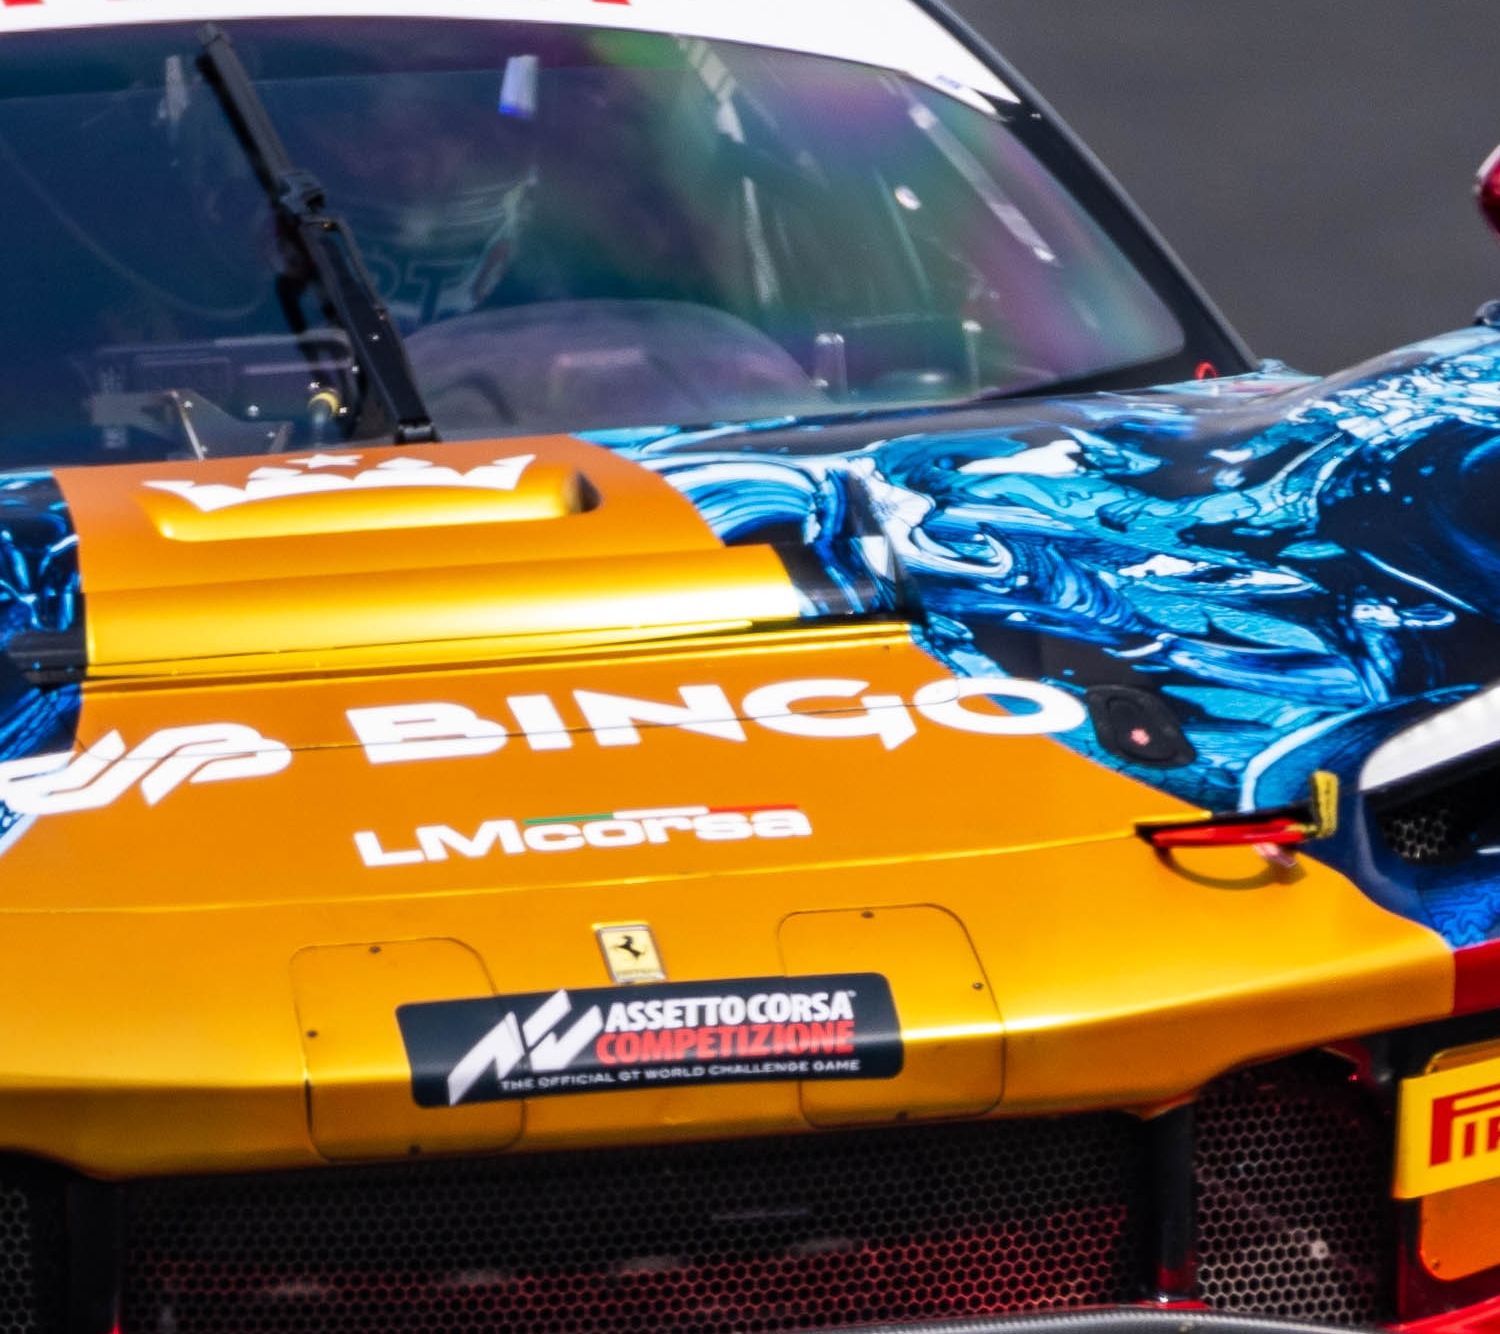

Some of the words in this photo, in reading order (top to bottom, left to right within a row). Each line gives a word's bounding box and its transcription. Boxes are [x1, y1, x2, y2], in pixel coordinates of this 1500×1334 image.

[345, 678, 1087, 765] BINGO
[352, 809, 814, 868] LMcorsa
[604, 994, 746, 1034] ASSETTO
[747, 990, 855, 1024] CORSA
[595, 1019, 856, 1066] COMPETIZIONE
[500, 1078, 535, 1092] THE
[536, 1074, 616, 1090] OFFICIAL
[618, 1070, 643, 1083] GT
[644, 1066, 706, 1080] WORLD
[707, 1060, 810, 1076] CHALLENGE
[812, 1059, 862, 1073] GAME
